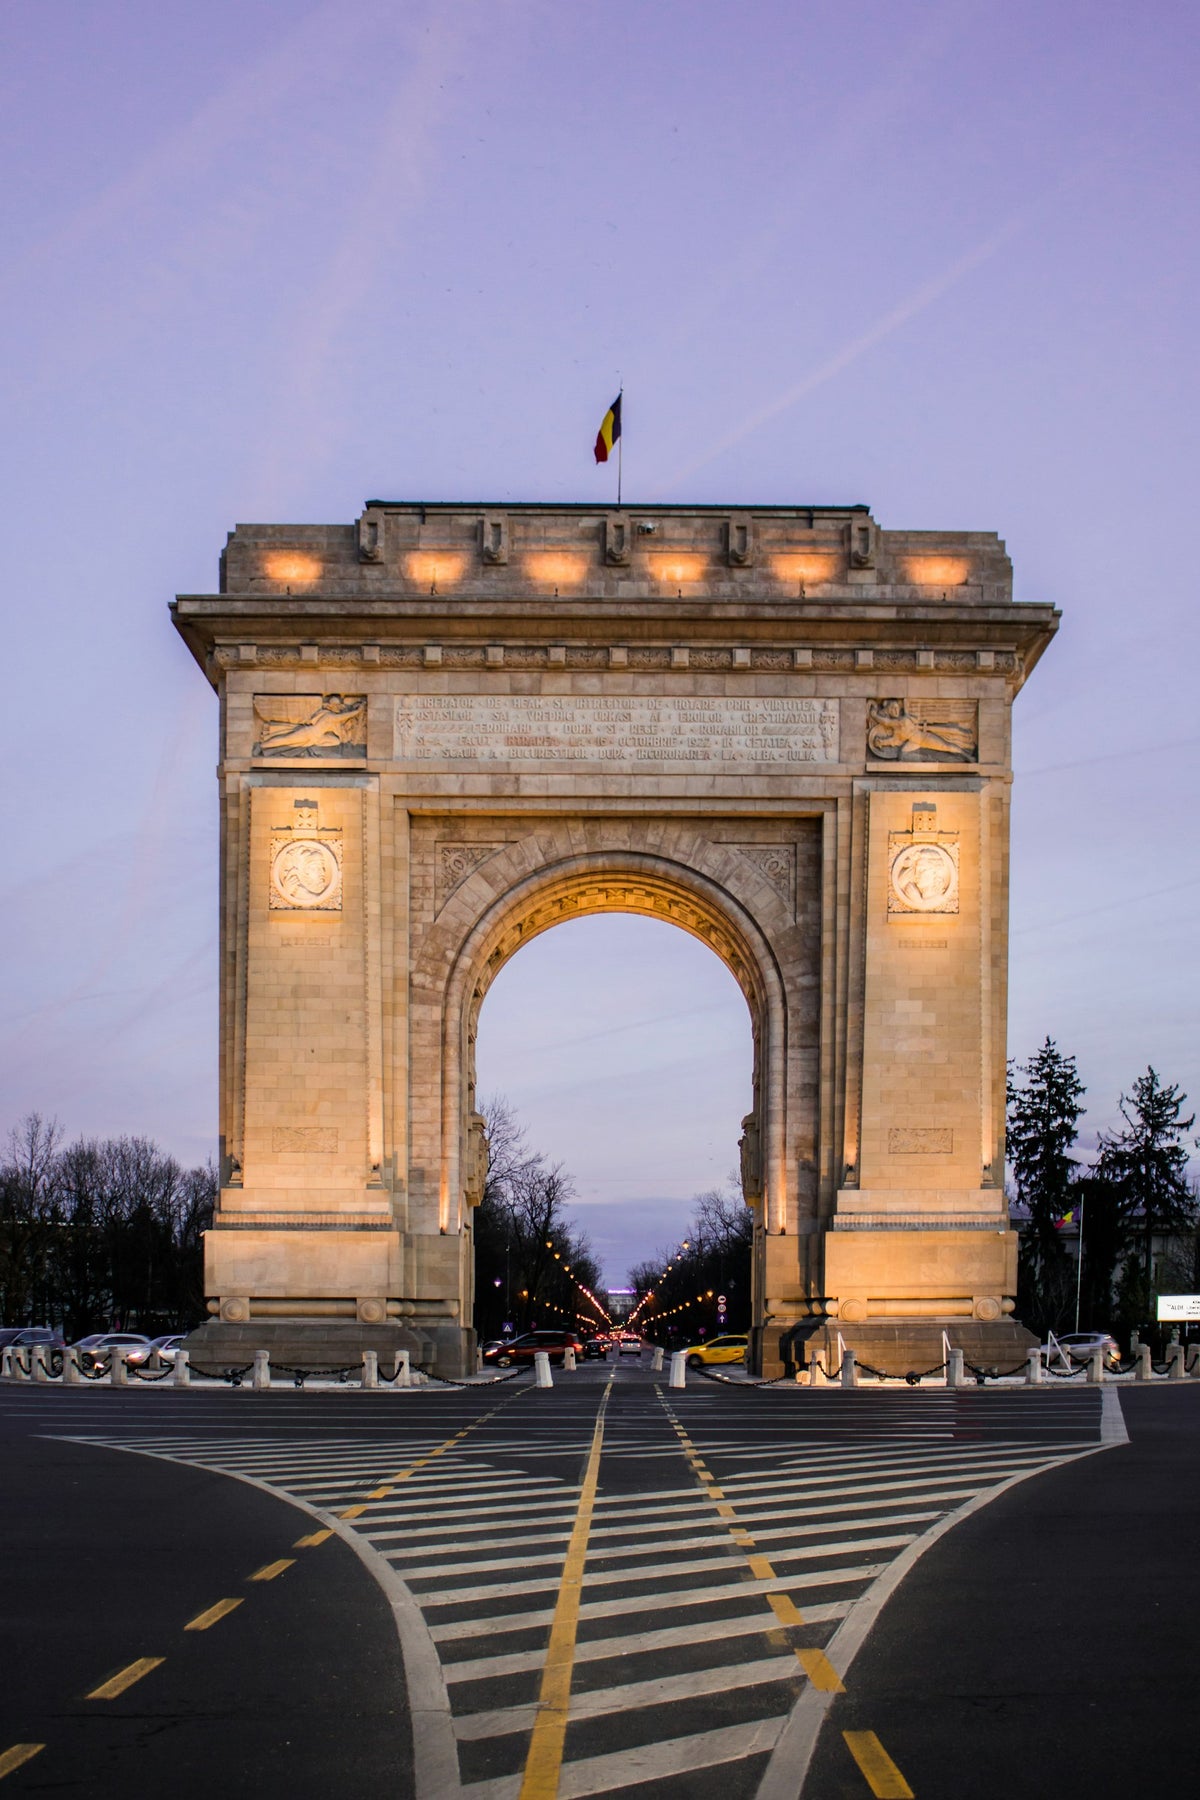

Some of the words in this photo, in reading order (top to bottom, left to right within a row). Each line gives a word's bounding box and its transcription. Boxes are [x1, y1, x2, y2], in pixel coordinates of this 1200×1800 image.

[487, 698, 501, 708] DE
[648, 700, 662, 710] DE
[416, 748, 432, 759] DE
